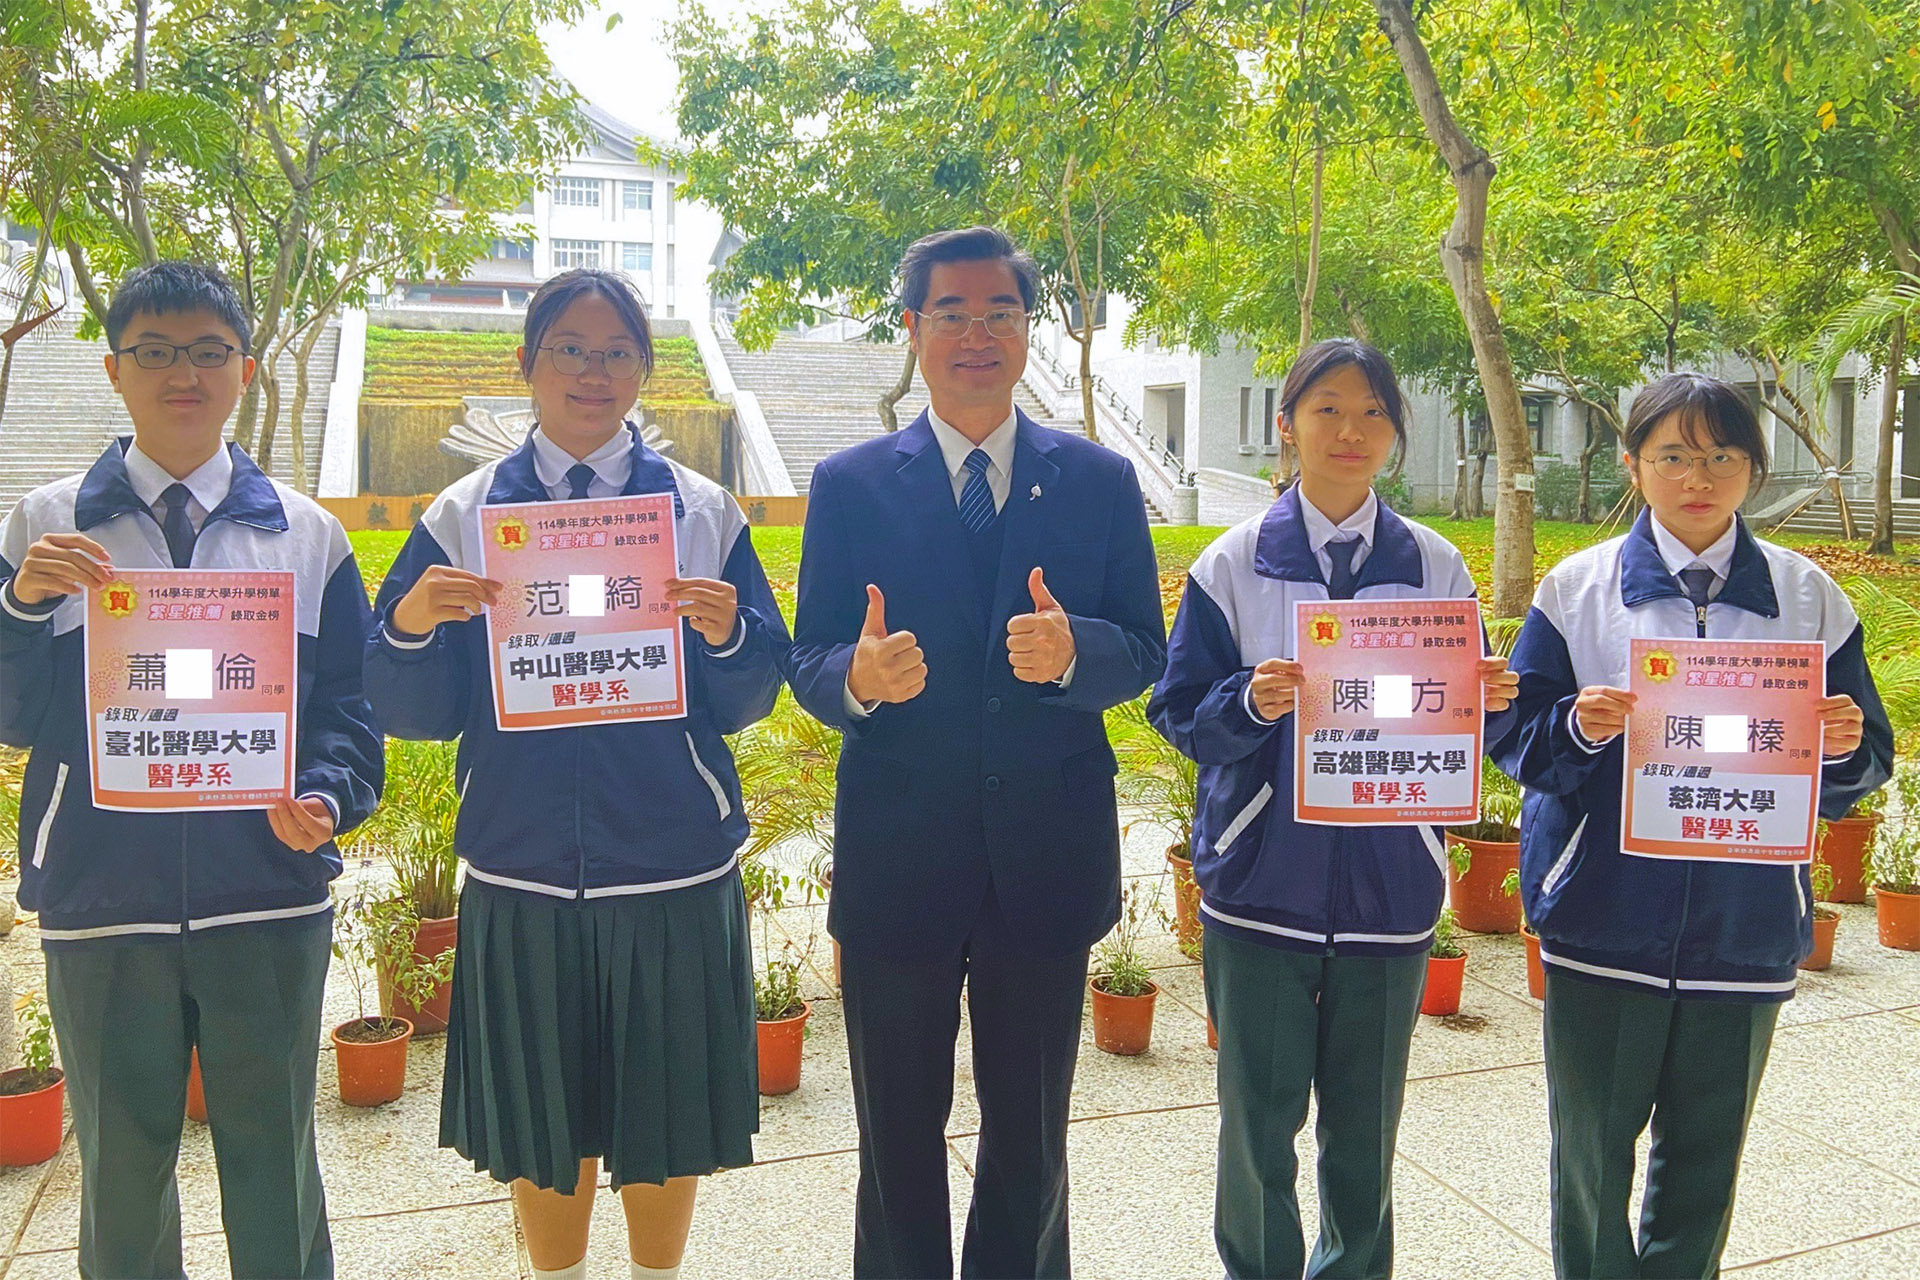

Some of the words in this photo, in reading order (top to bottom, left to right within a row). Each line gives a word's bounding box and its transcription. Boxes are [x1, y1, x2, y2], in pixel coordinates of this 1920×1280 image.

[537, 512, 659, 530] 114學年度大學升學榜單
[502, 525, 522, 545] 賀
[539, 531, 608, 551] 繁星推薦
[615, 533, 660, 547] 錄取金榜
[109, 591, 130, 611] 賀
[148, 587, 280, 599] 114學年度大學升學榜單
[148, 604, 224, 621] 繁星推薦
[231, 609, 279, 621] 錄取金榜
[648, 602, 671, 614] 同學
[1315, 622, 1334, 641] 賀
[1350, 615, 1466, 628] 114學年度大學升學榜單
[1350, 631, 1417, 649] 繁星推薦
[1422, 637, 1467, 648] 錄取金榜
[509, 645, 667, 682] 中山醫學大學
[1650, 657, 1669, 677] 賀
[1686, 656, 1810, 669] 114學年度大學升學榜單
[261, 684, 285, 695] 同學
[1685, 670, 1757, 688] 繁星推薦
[1762, 678, 1809, 690] 錄取金榜
[552, 679, 630, 707] 醫學系
[1452, 707, 1474, 718] 同學
[105, 729, 276, 757] 臺北醫學大學
[1313, 750, 1466, 776] 高雄醫學大學
[1789, 749, 1811, 759] 同學
[148, 762, 232, 788] 醫學系
[1352, 781, 1428, 804] 醫學系
[1668, 785, 1776, 813] 慈濟大學
[1681, 816, 1760, 841] 醫學系
